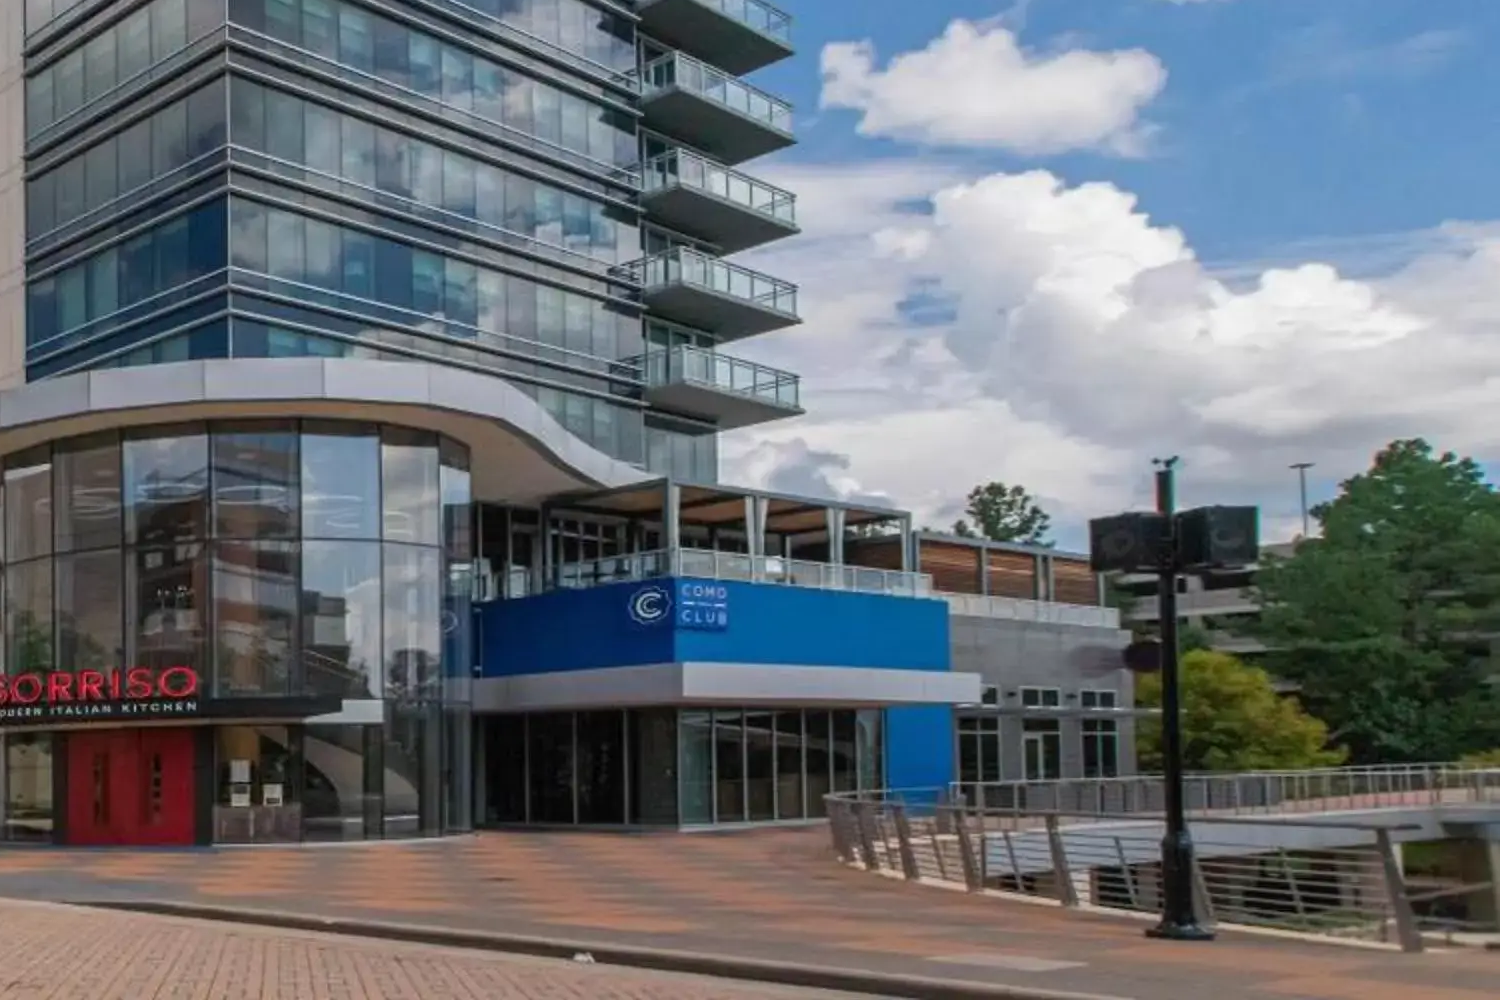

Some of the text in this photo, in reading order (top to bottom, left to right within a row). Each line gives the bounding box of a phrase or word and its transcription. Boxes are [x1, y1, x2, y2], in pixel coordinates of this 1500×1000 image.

[681, 583, 727, 599] COMO
[681, 609, 727, 625] CLUB
[49, 704, 112, 716] ITALIAN
[121, 701, 198, 714] KITCHEN
